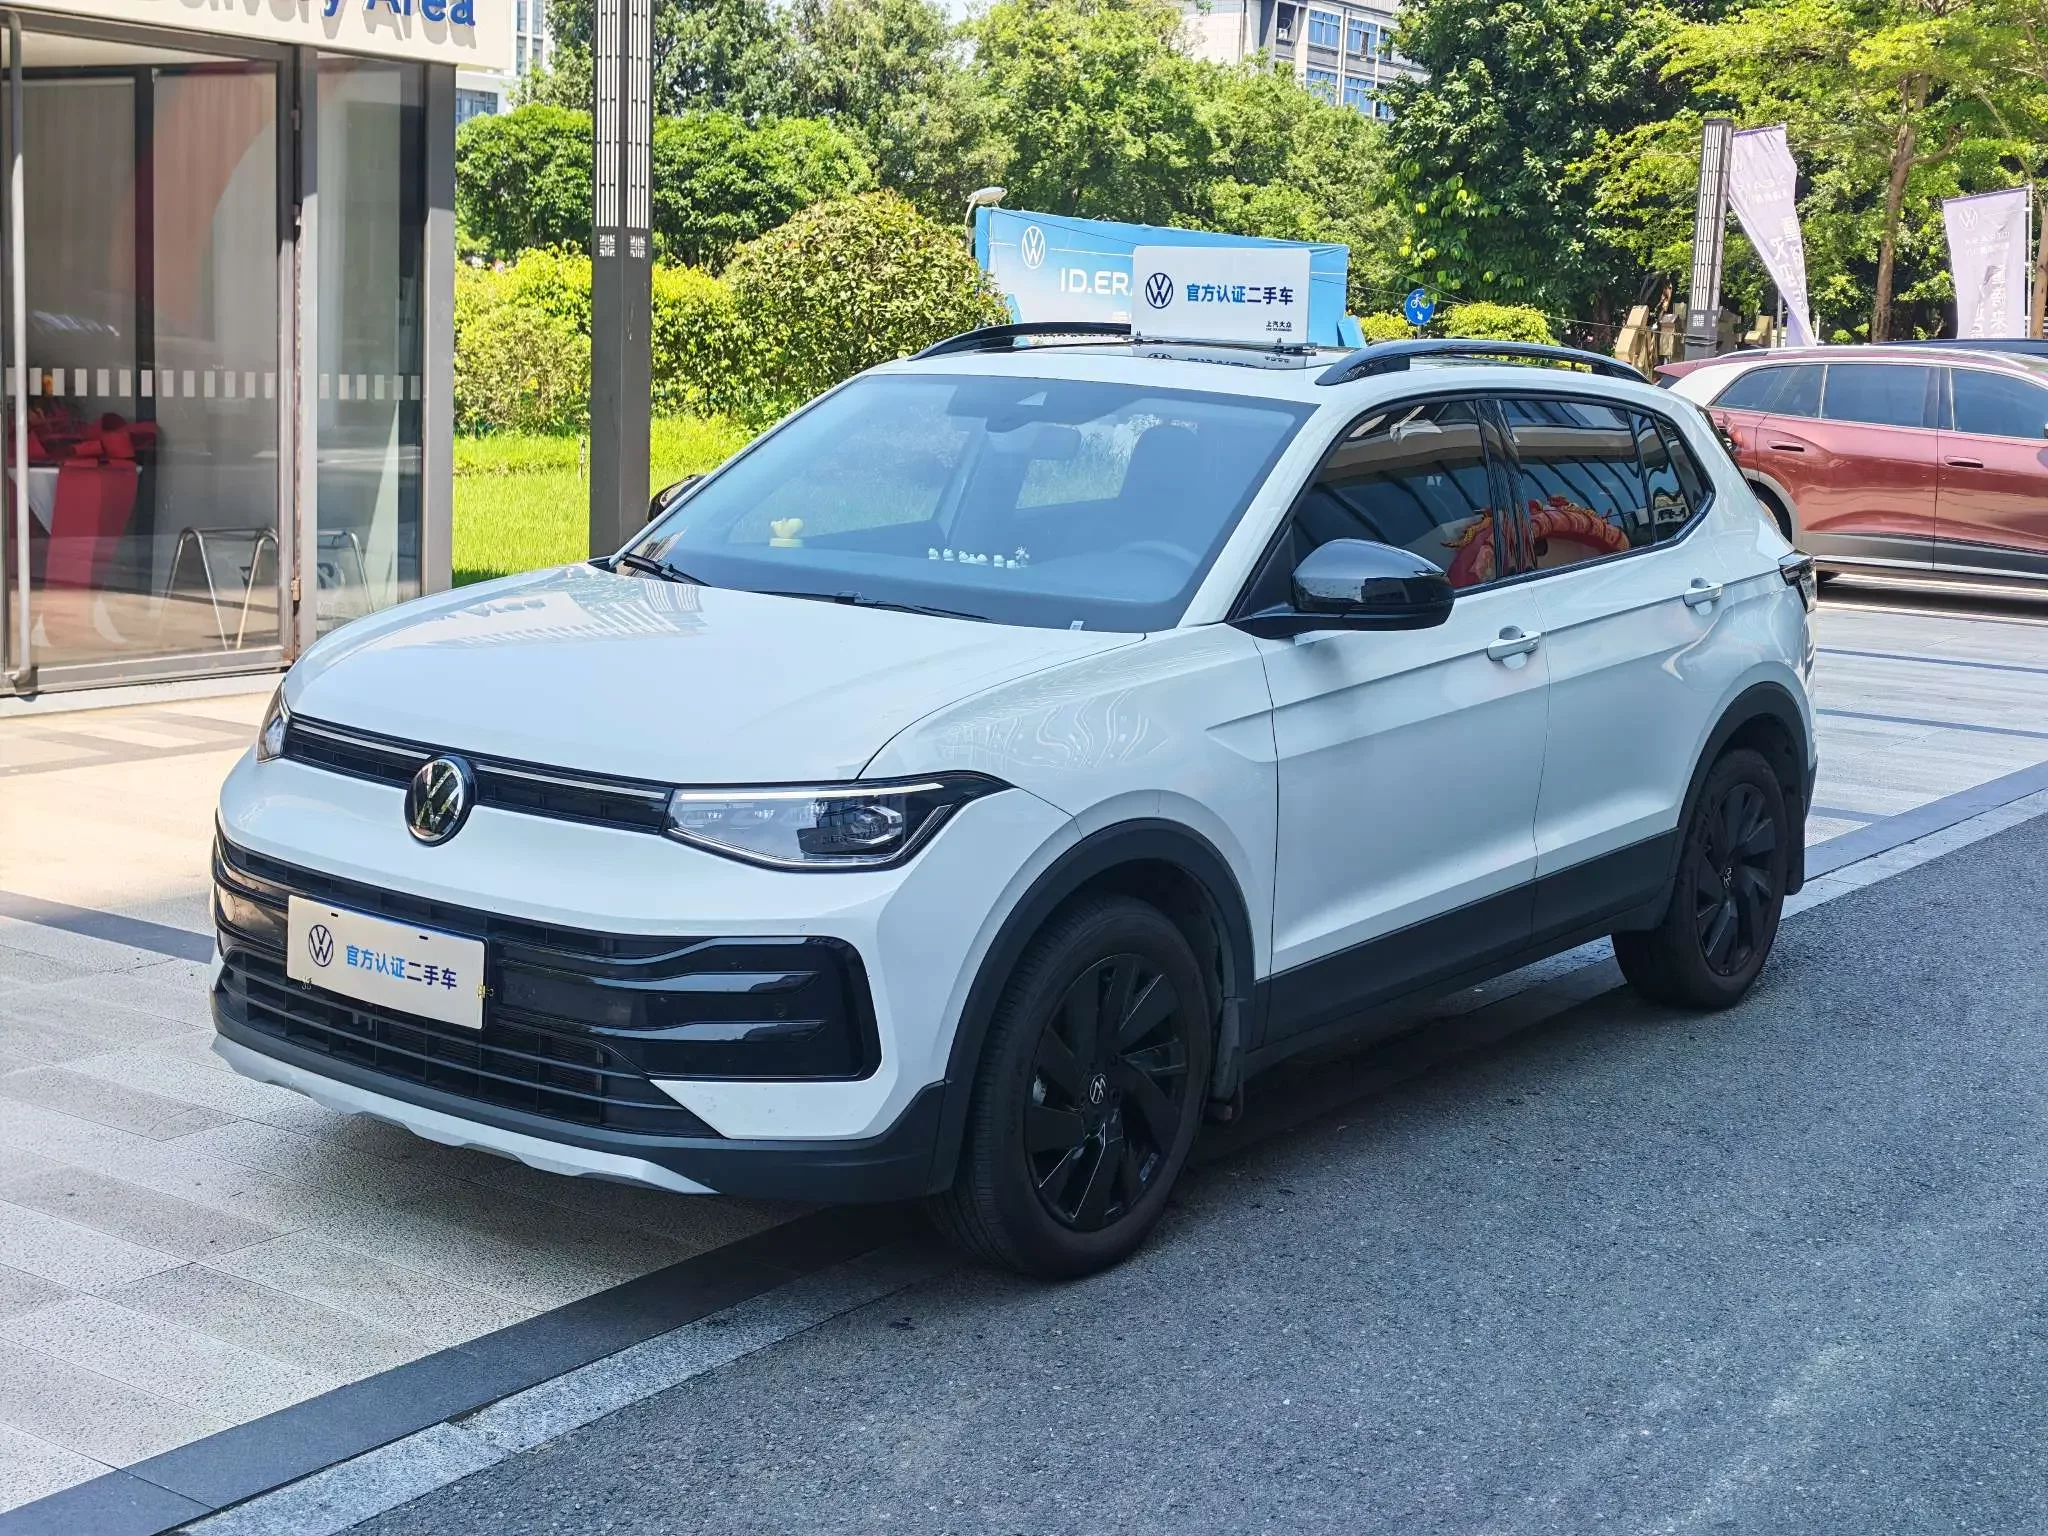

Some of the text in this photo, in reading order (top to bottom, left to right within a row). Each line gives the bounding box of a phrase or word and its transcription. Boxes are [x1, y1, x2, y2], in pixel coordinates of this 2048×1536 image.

[1060, 267, 1133, 297] ID.ER
[1187, 284, 1294, 306] 官方认证二手车
[346, 944, 457, 990] 官方认证二手车
